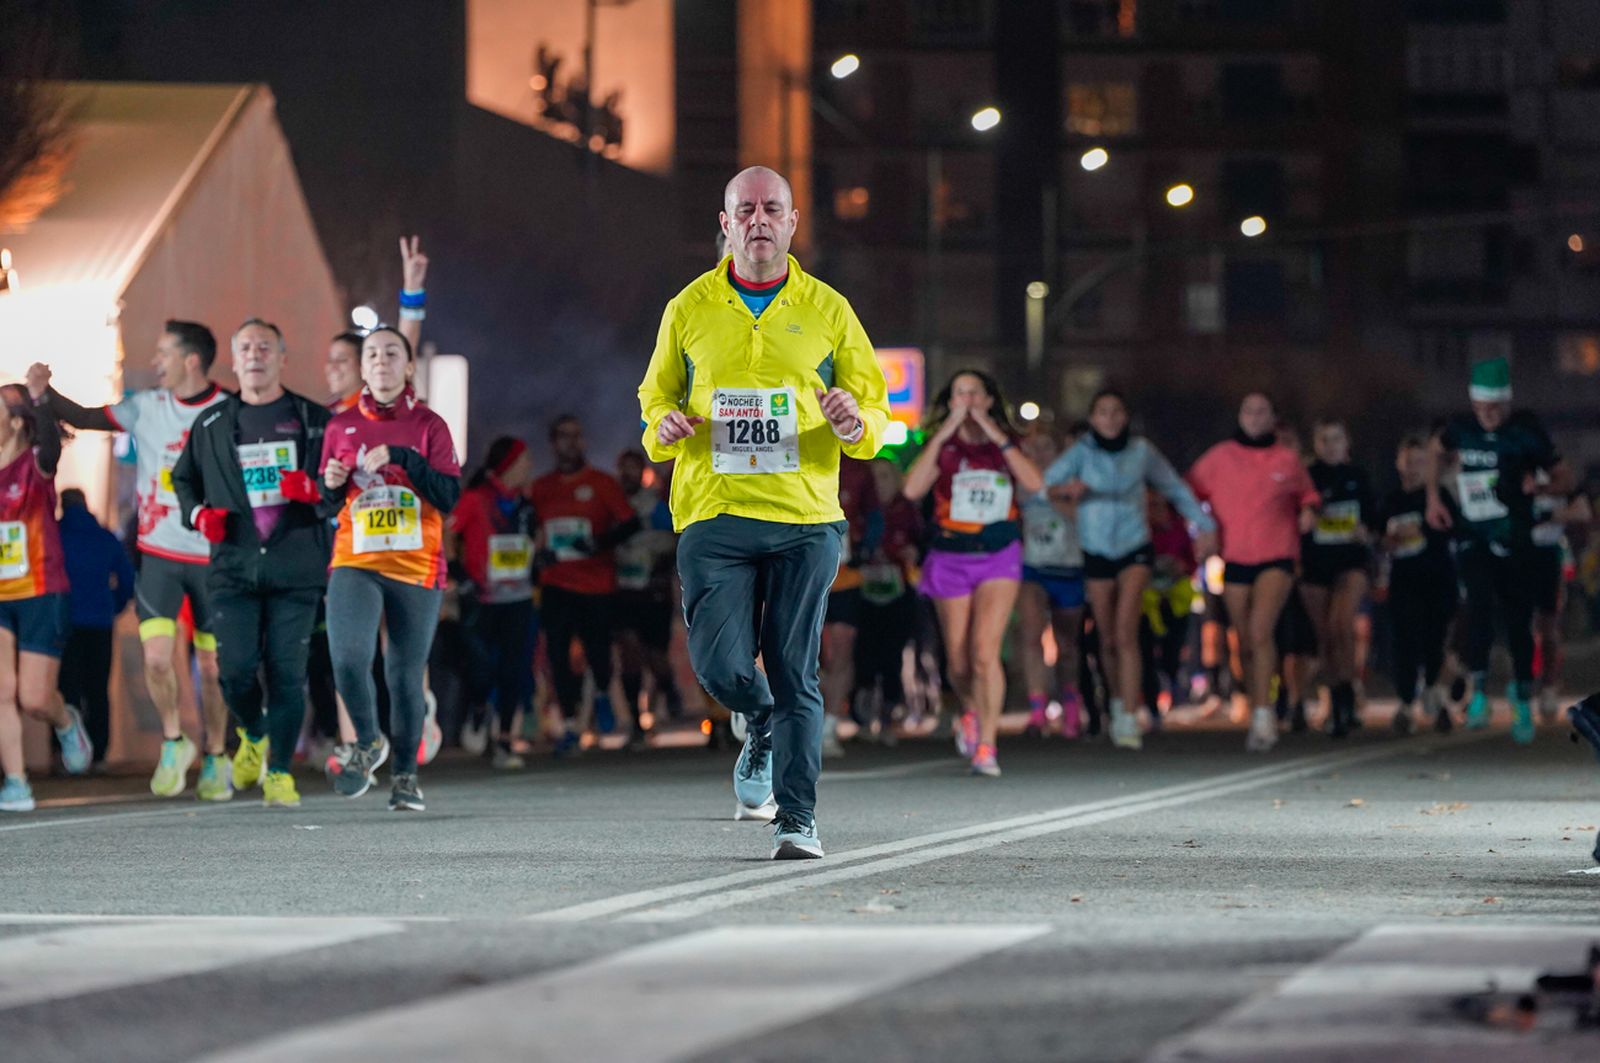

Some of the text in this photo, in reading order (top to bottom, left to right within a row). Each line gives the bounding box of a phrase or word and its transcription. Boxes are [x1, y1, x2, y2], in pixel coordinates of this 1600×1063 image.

[727, 398, 754, 407] NOCHE
[719, 408, 736, 417] SAN
[726, 419, 780, 444] 1288
[368, 509, 405, 528] 1201
